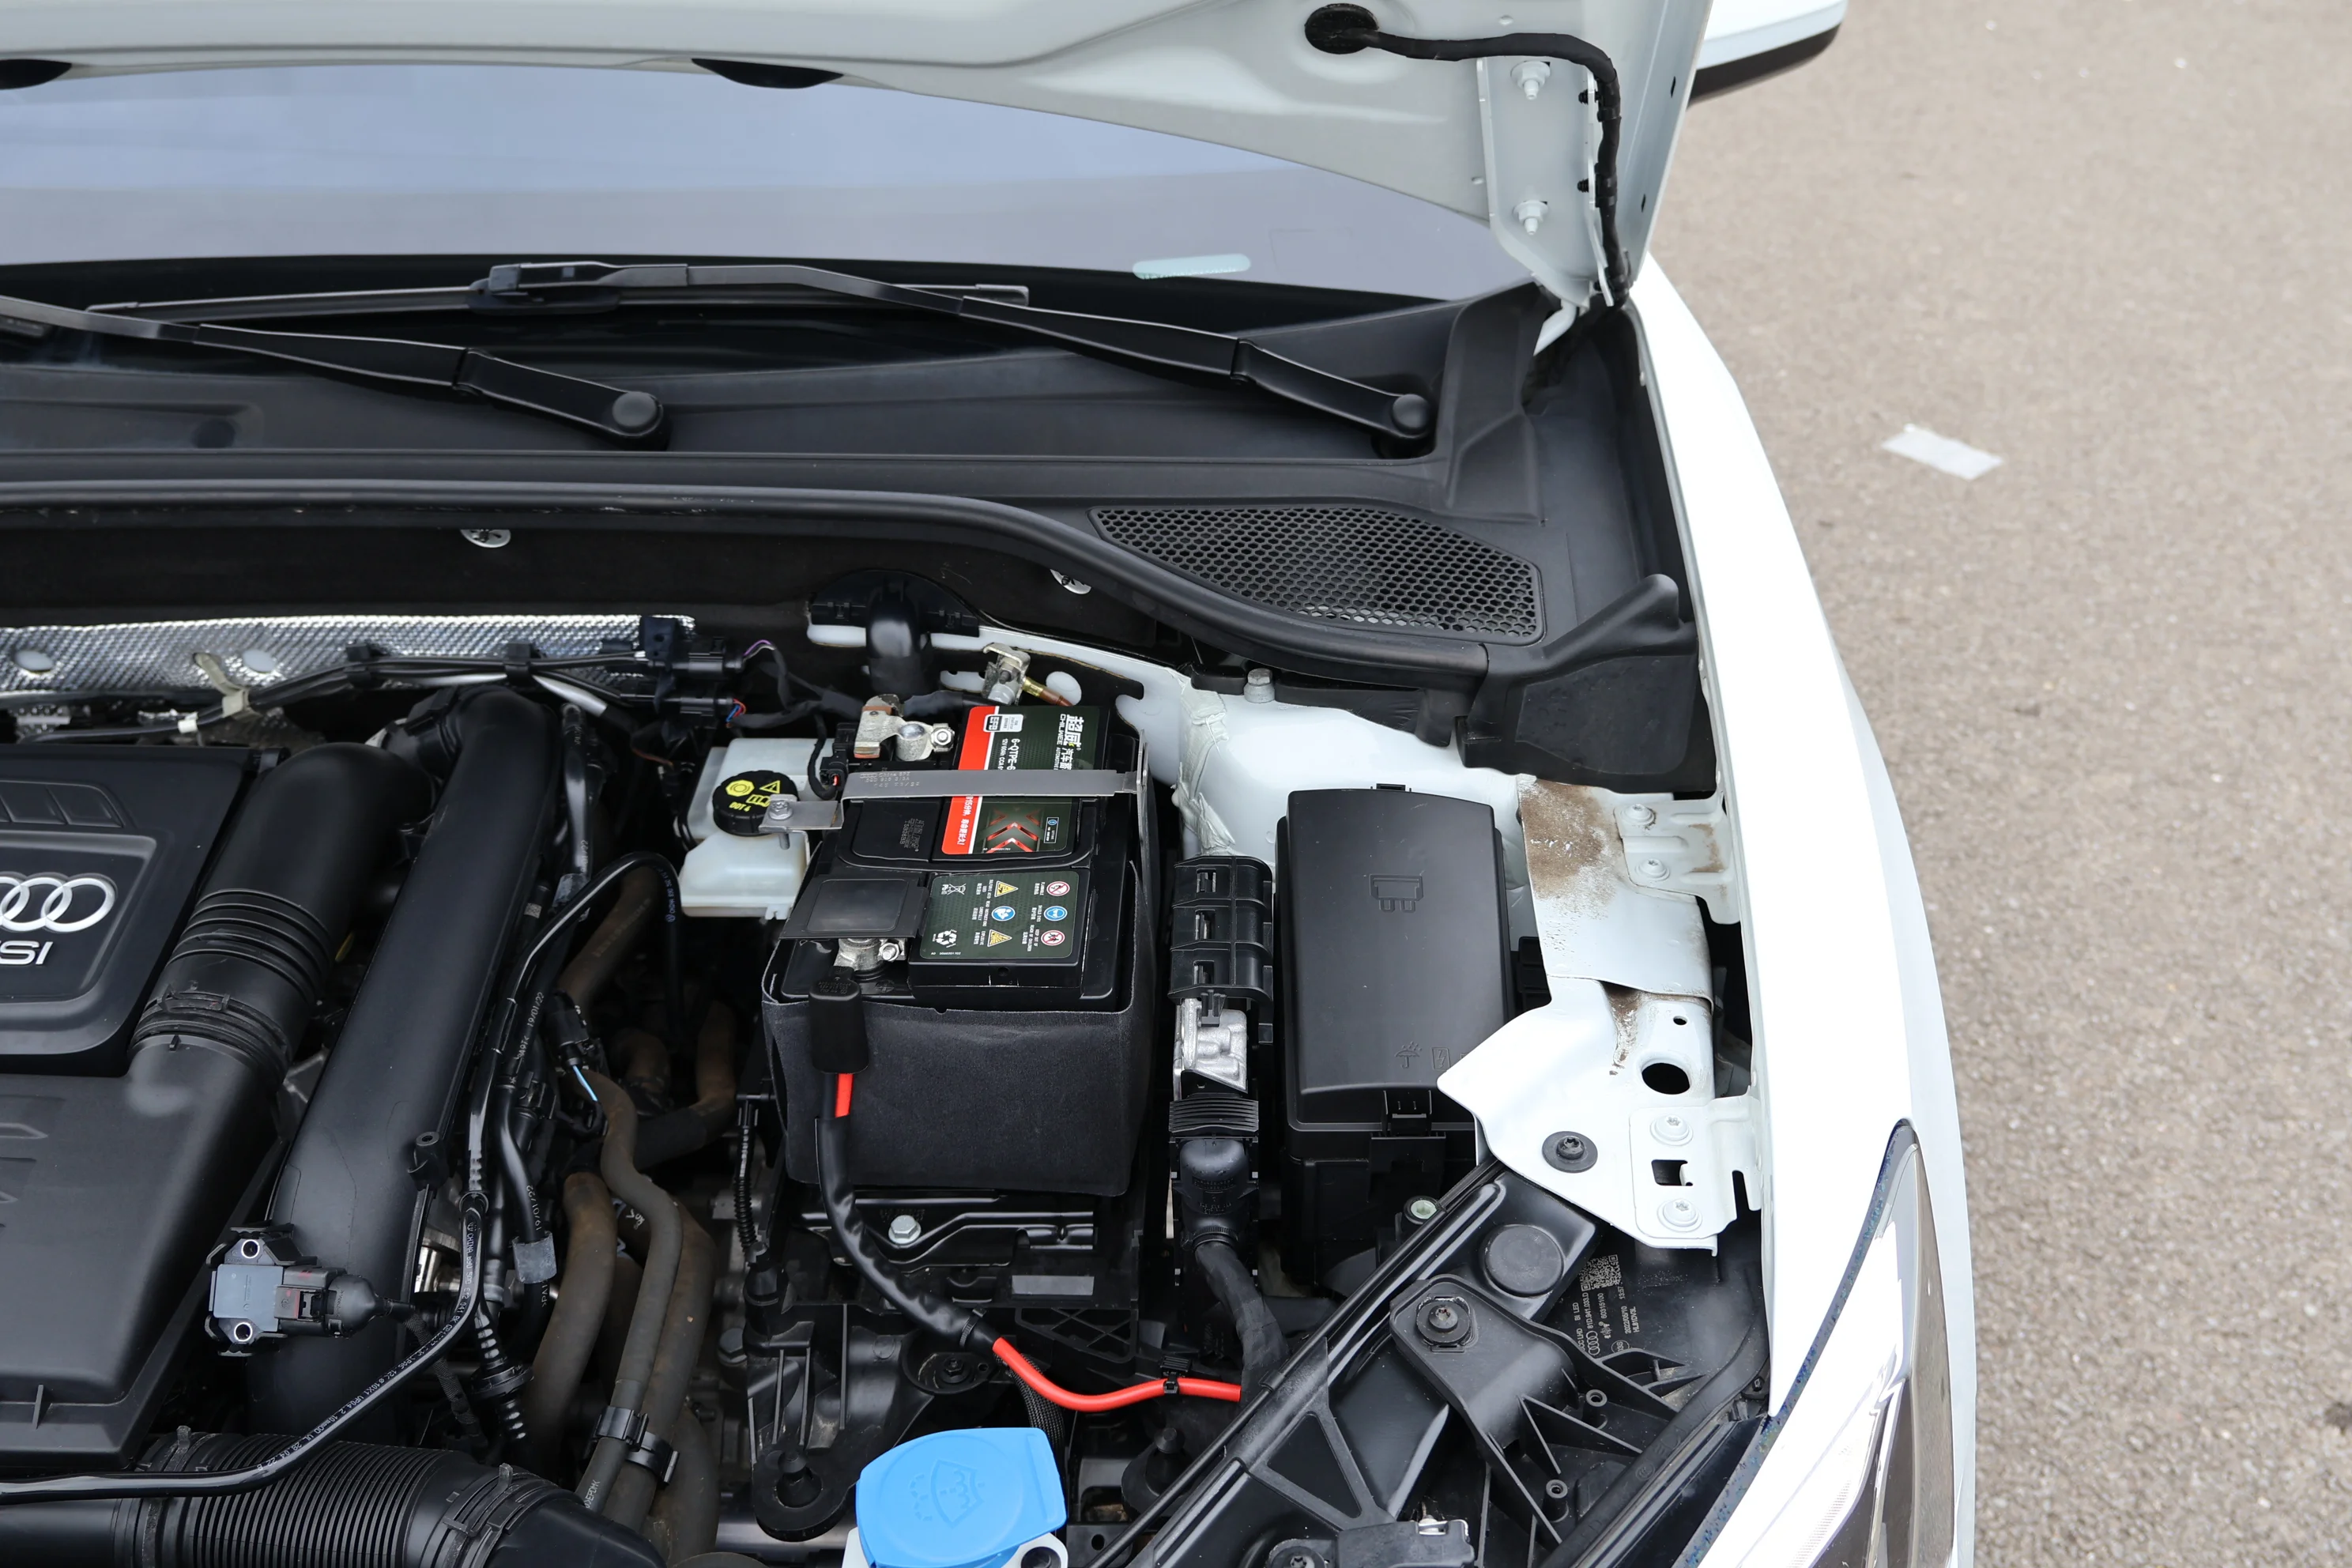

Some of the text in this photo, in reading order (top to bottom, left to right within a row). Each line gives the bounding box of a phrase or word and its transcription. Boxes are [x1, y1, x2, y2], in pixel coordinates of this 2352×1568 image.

[988, 717, 1000, 730] EFB
[1057, 714, 1066, 745] CHILWEE
[1063, 714, 1085, 748] 超威
[729, 801, 747, 811] DOT
[0, 940, 54, 965] SI
[526, 1185, 542, 1231] 19/01/22
[1618, 1287, 1632, 1333] 2022/05/10 13:57
